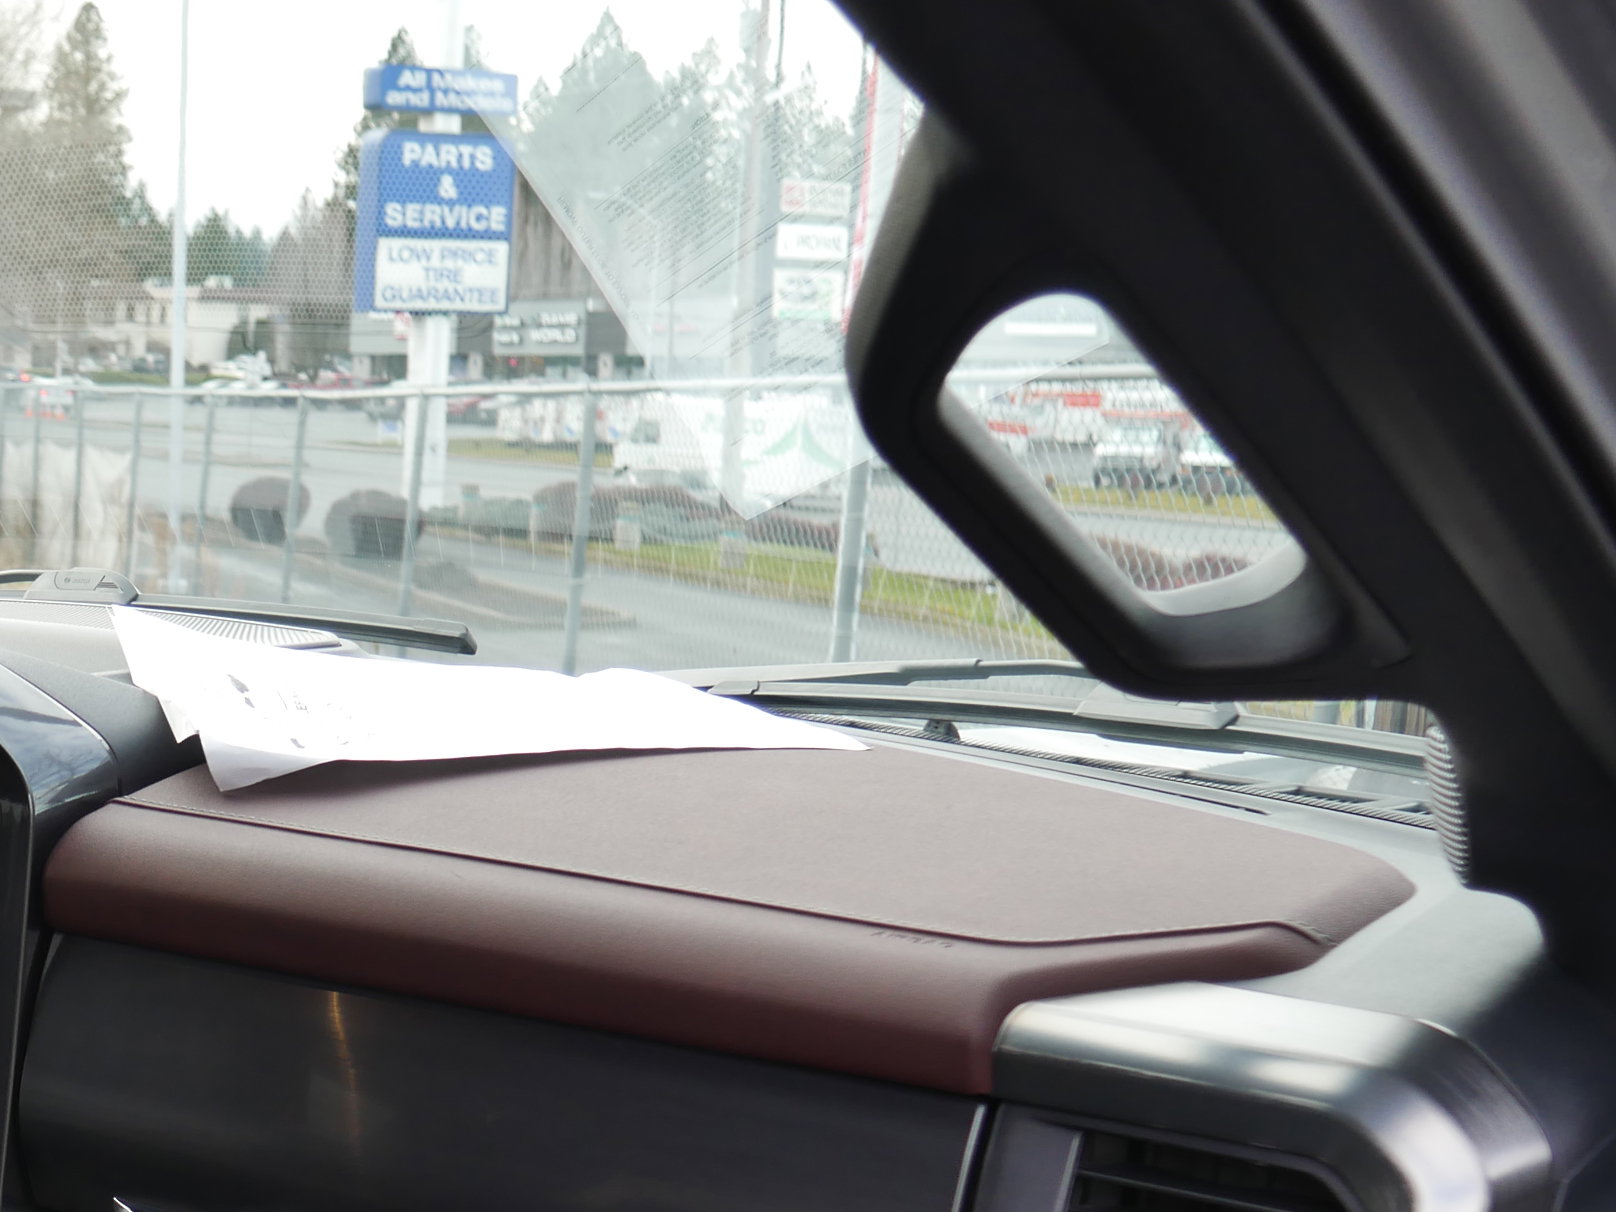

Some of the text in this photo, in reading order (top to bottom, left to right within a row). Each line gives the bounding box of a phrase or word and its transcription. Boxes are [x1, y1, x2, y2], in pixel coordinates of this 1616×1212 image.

[397, 69, 427, 89] All
[386, 90, 430, 108] and
[401, 141, 495, 171] PARTS
[438, 173, 458, 199] &
[384, 202, 507, 231] SERVICE
[388, 246, 496, 265] LOW PRICE
[423, 266, 462, 283] TIRE
[382, 286, 500, 304] GUARANTEE
